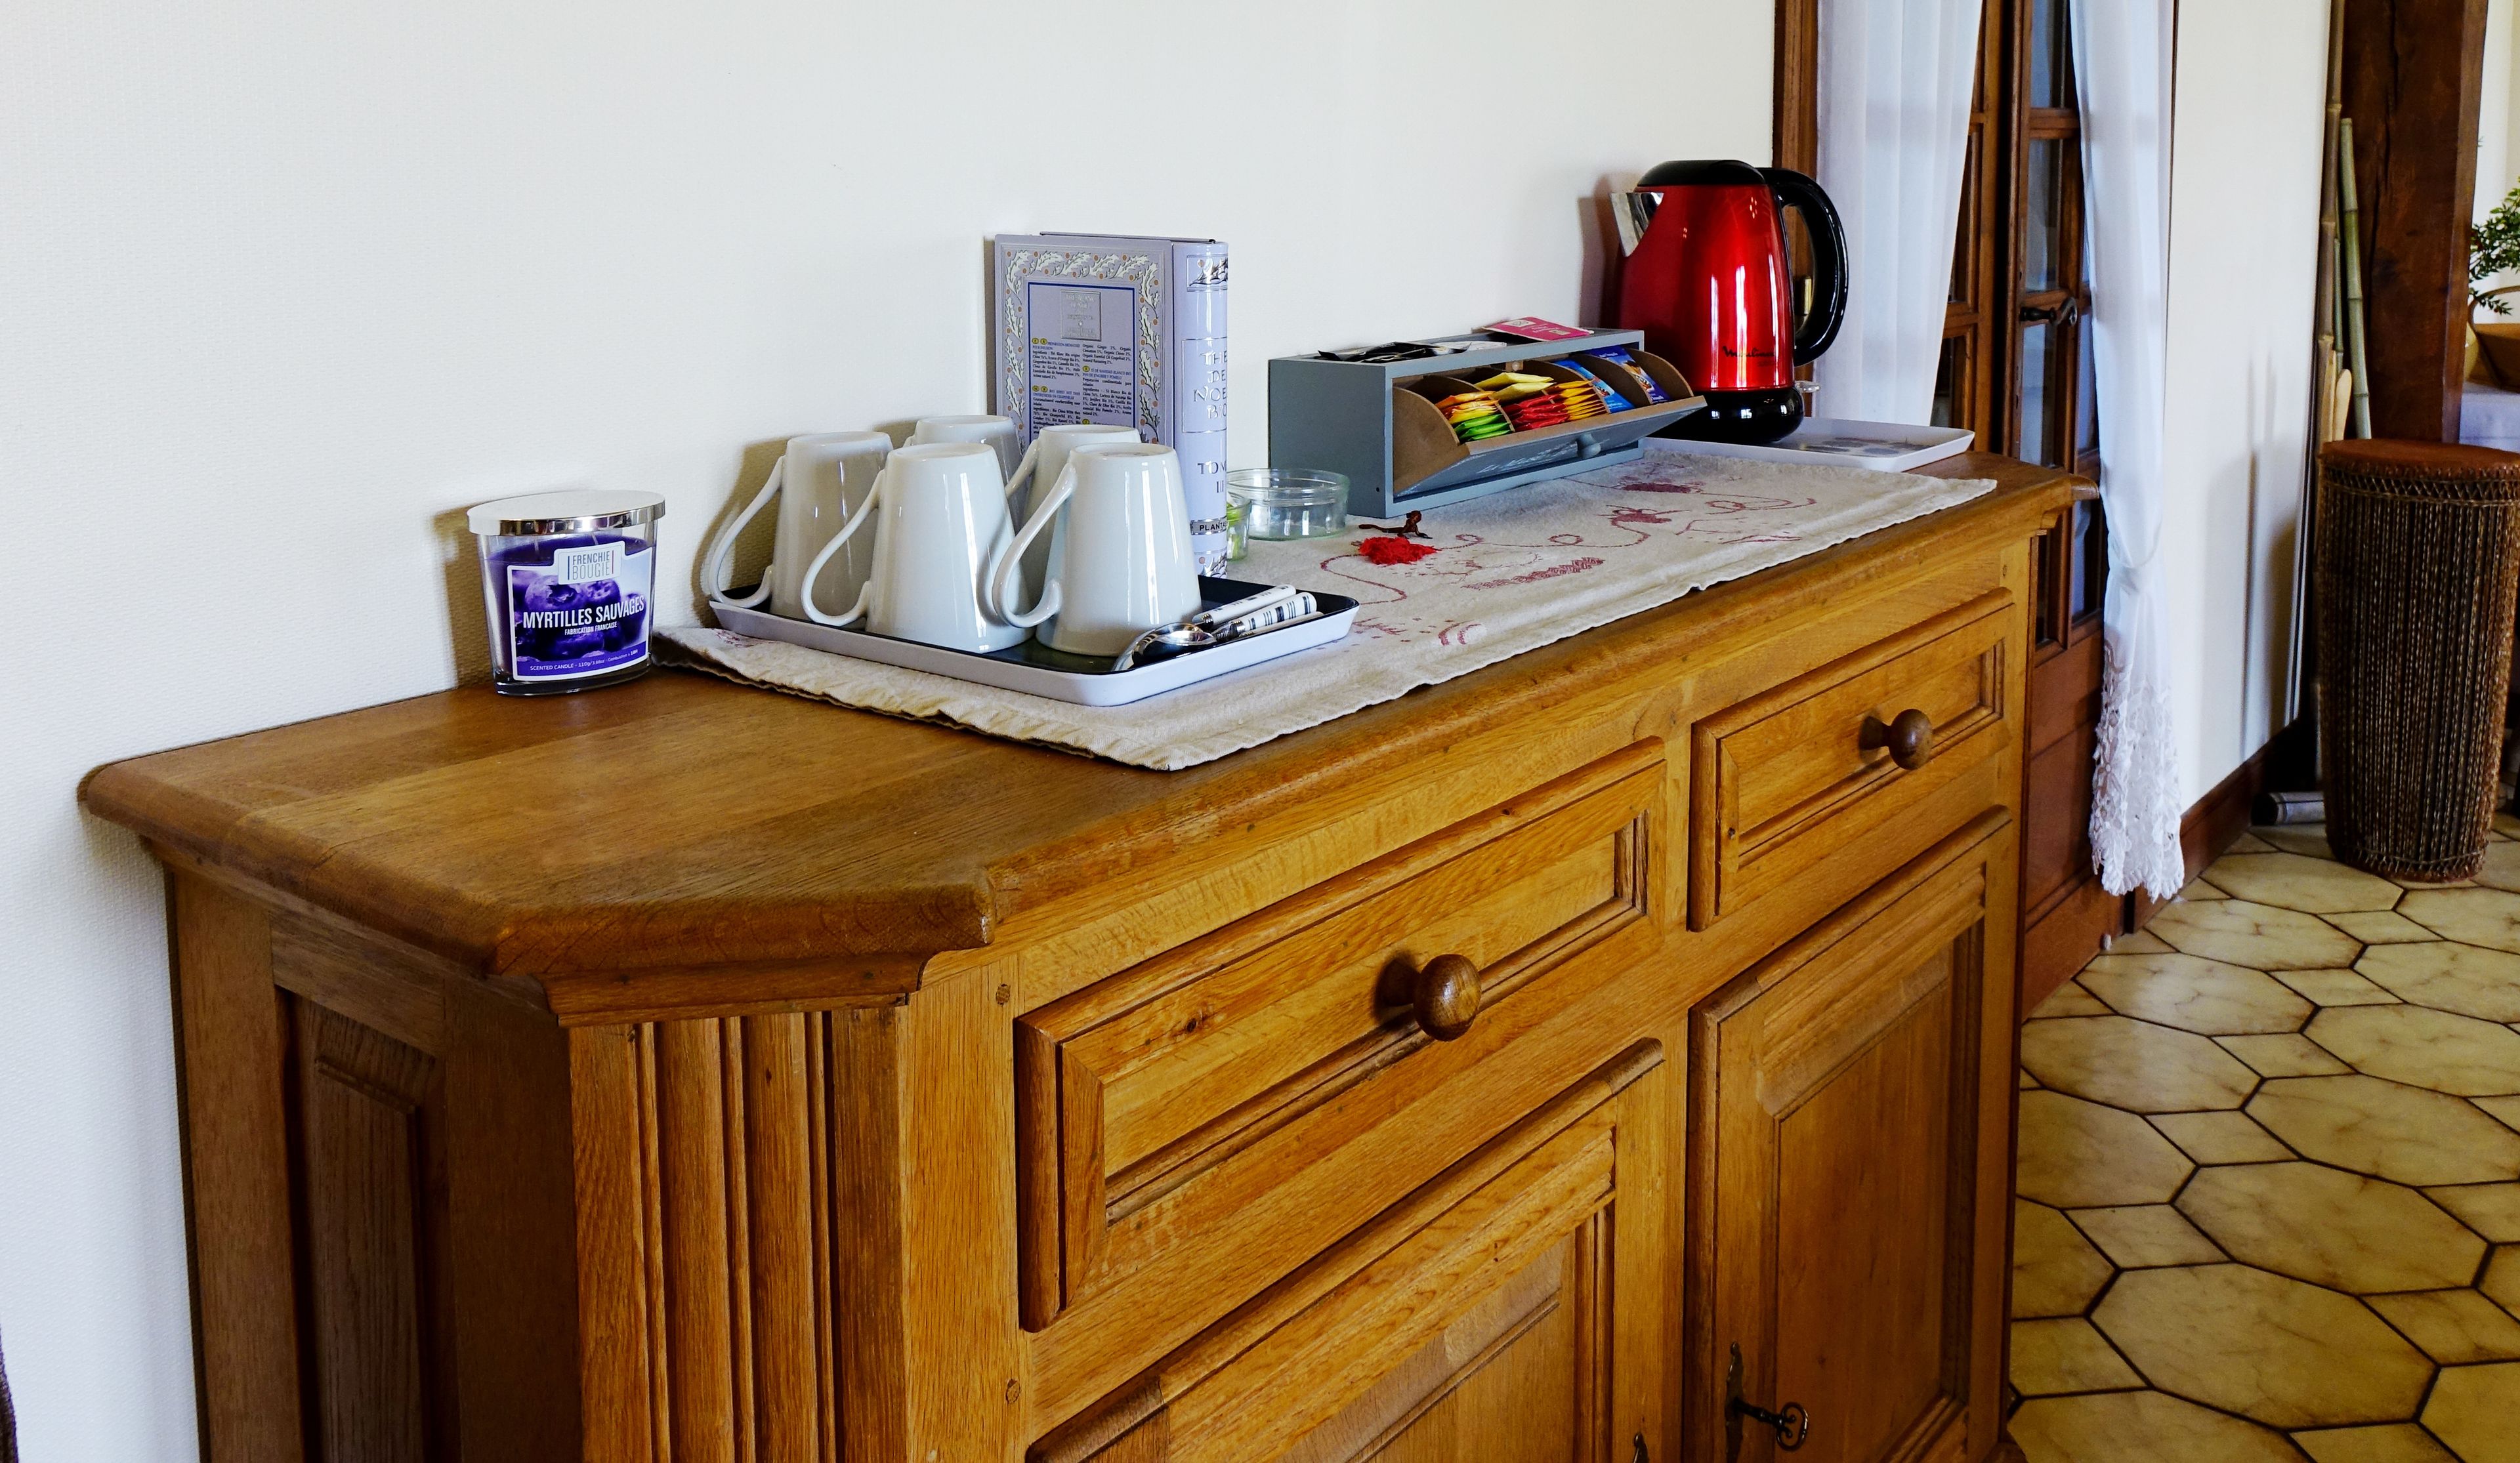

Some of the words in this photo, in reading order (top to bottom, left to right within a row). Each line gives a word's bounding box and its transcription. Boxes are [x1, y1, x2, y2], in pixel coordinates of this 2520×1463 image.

[1208, 369, 1226, 382] DE
[572, 550, 610, 566] FRENCHIE
[572, 561, 610, 580] BOUGIE
[522, 608, 593, 629] MYRTILLES
[595, 595, 644, 623] SAUVAGES
[564, 625, 594, 636] FABRICATION
[595, 621, 618, 633] FRANÇAISE
